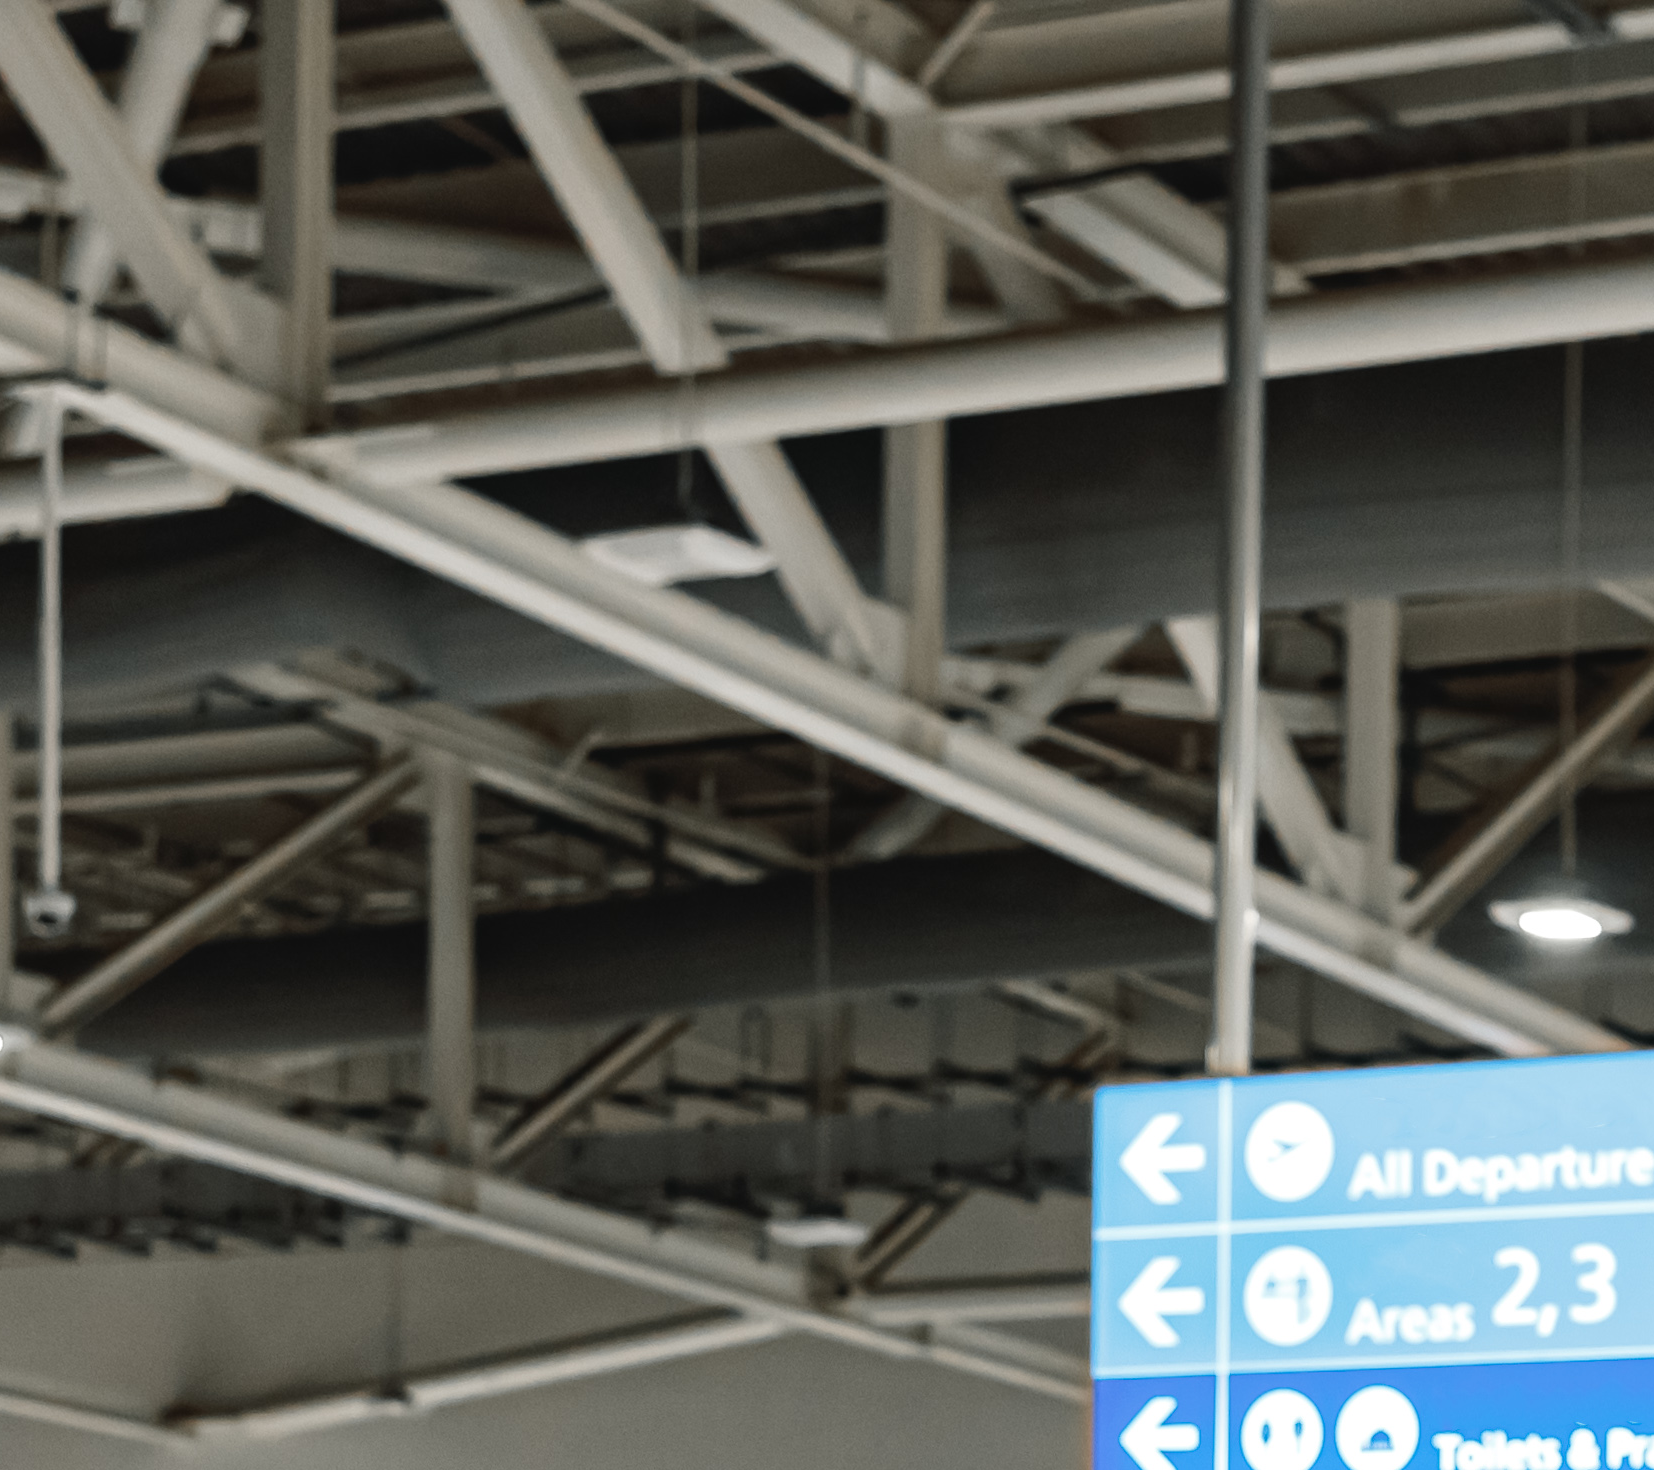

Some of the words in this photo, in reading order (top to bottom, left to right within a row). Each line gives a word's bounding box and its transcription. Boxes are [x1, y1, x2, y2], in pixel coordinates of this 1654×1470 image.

[1347, 1148, 1412, 1200] All
[1345, 1298, 1475, 1345] Areas
[1492, 1243, 1618, 1337] 2,3
